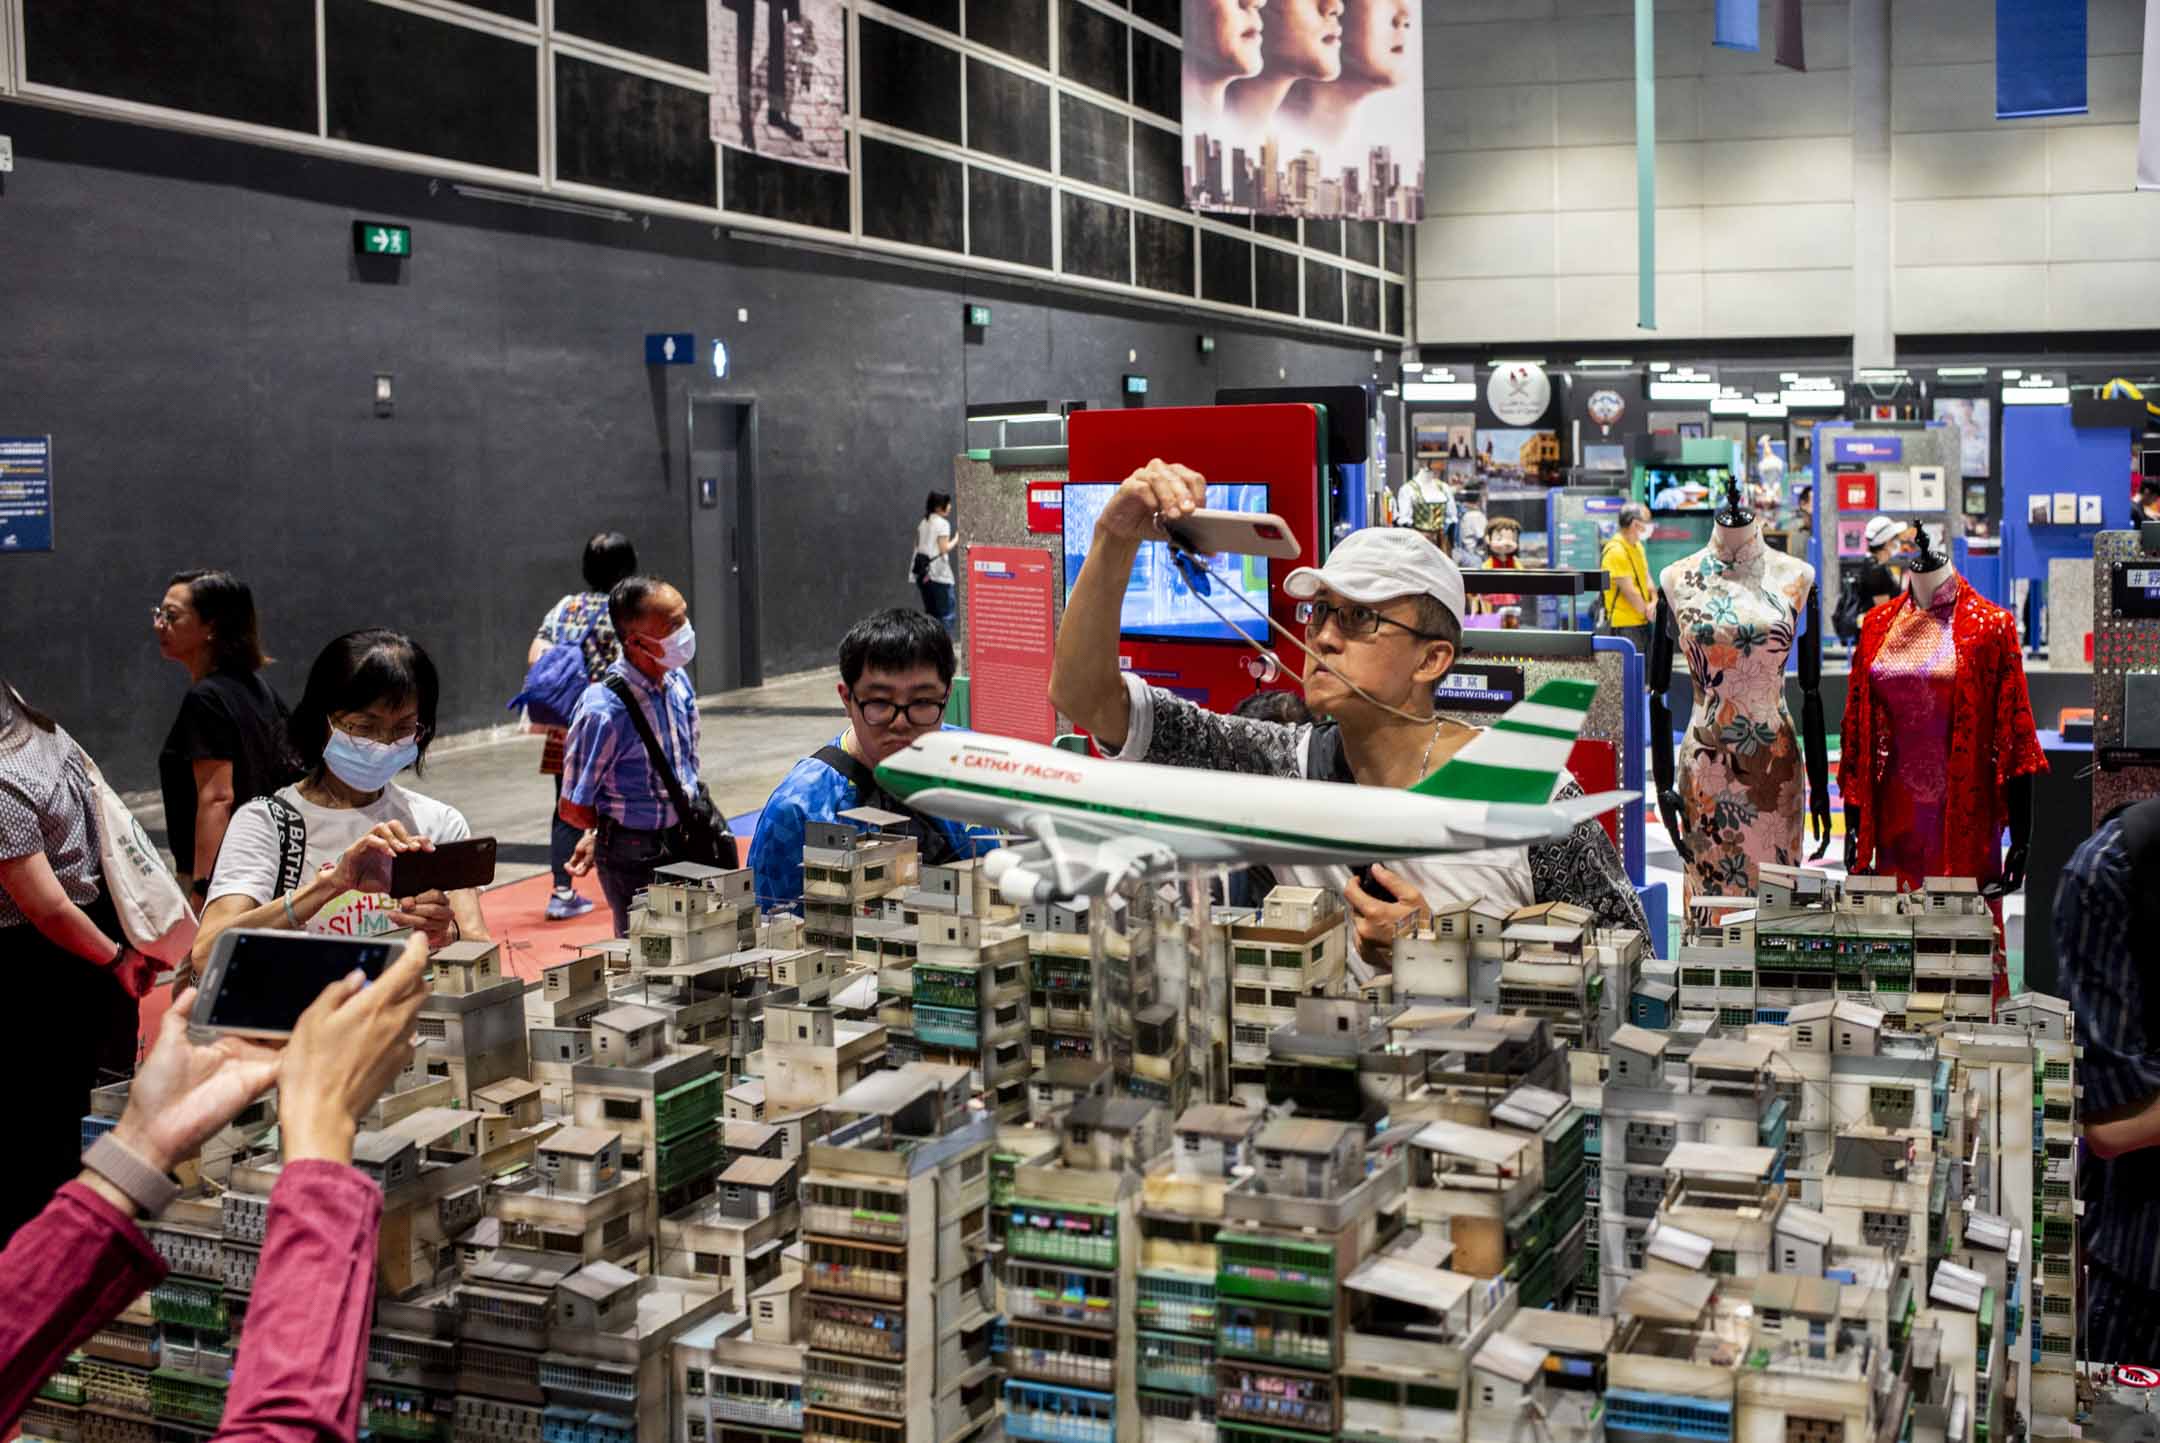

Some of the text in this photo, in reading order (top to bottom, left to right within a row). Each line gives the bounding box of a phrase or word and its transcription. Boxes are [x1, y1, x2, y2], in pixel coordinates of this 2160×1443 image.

[964, 754, 1082, 784] CATHAY PACIFIC
[284, 808, 304, 891] A BATHI
